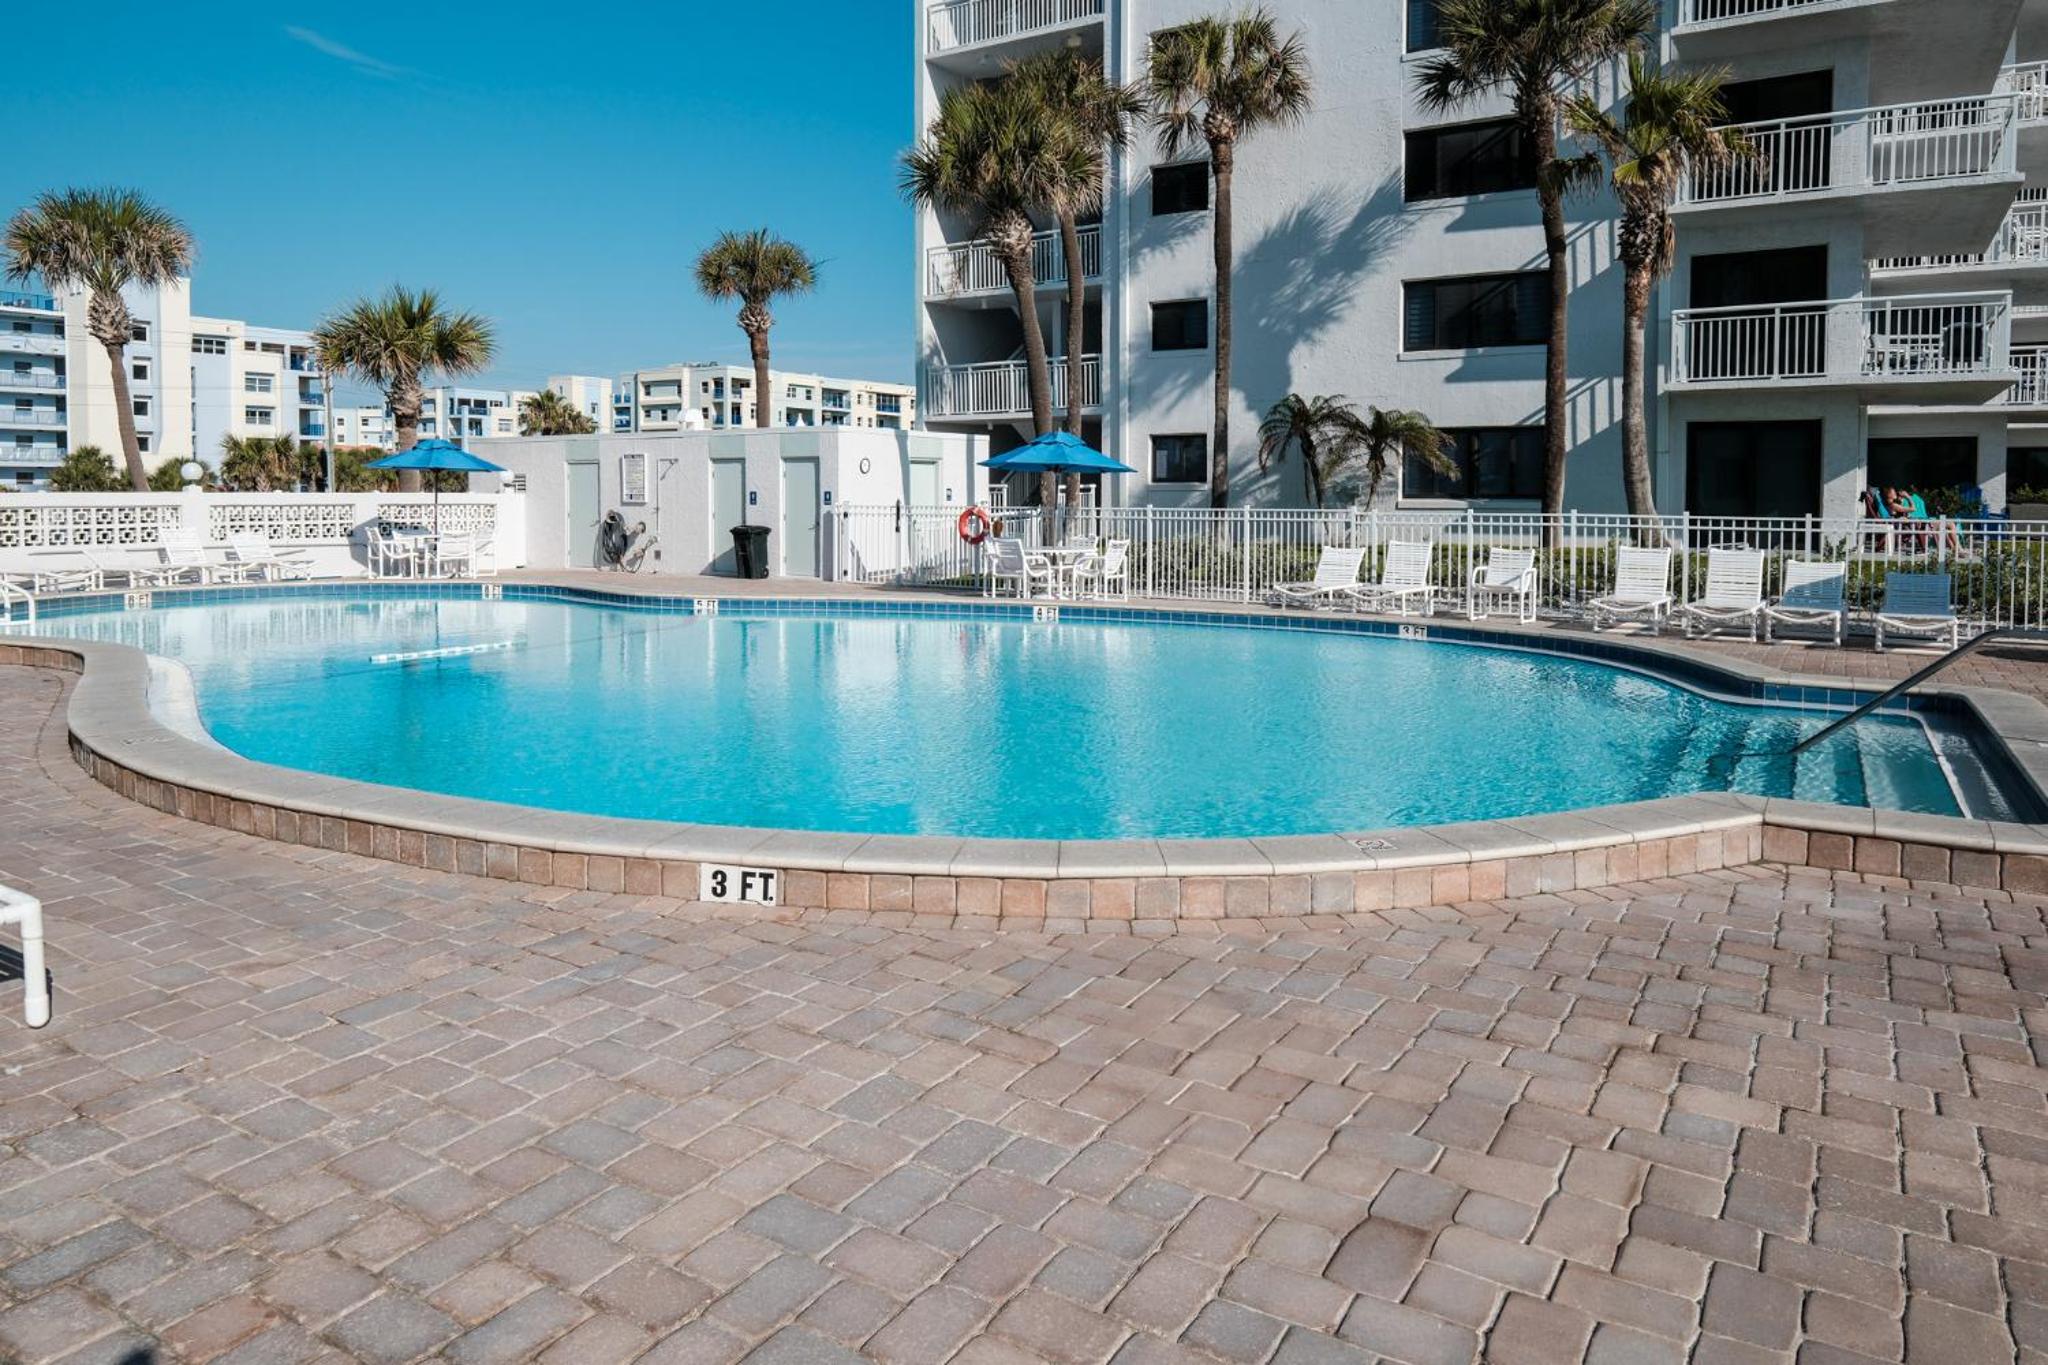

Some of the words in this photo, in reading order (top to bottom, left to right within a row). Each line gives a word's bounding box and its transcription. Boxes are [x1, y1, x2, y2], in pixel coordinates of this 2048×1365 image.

[1413, 626, 1426, 637] FT
[711, 870, 727, 898] 3
[740, 871, 775, 901] FT.
